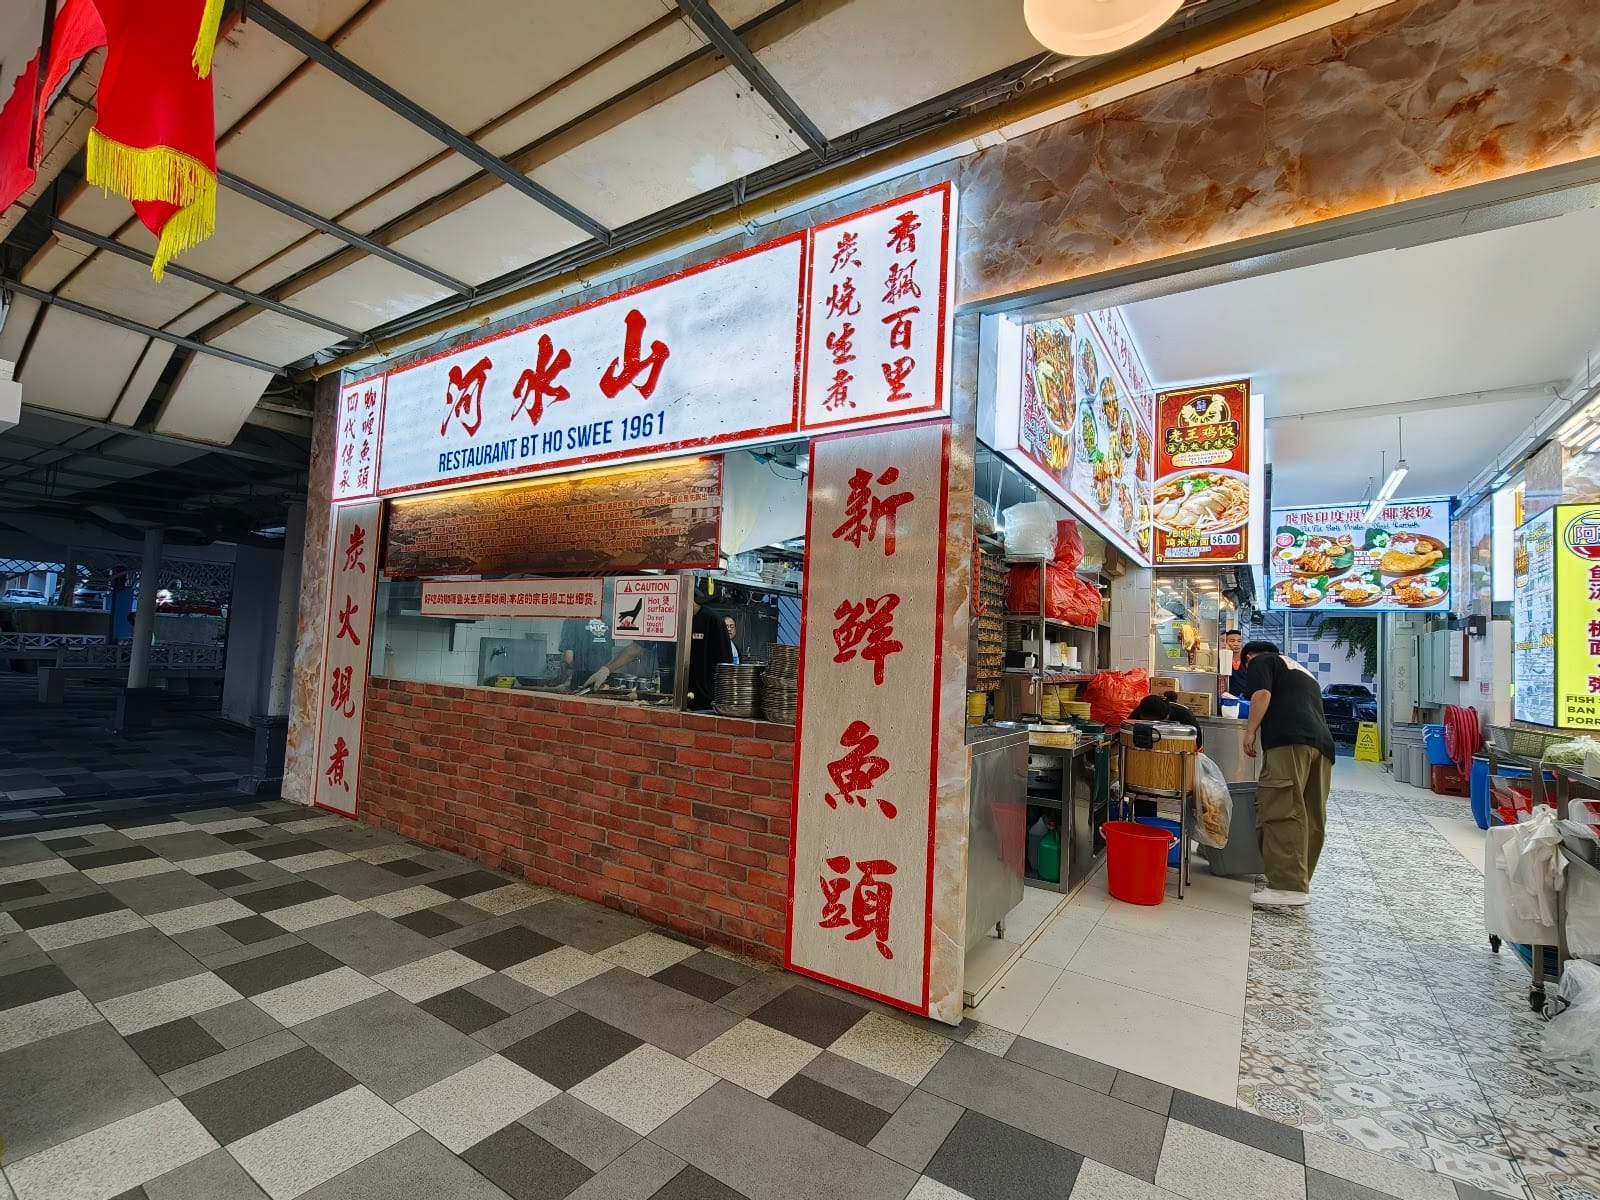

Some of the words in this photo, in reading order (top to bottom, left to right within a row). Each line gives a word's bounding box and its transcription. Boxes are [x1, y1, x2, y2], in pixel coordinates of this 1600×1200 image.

[440, 308, 671, 437] 河水山
[1168, 422, 1236, 442] 老王鸡饭
[438, 438, 518, 472] RESTAURANT
[520, 434, 539, 458] BT
[543, 430, 563, 454] HO
[567, 420, 614, 450] SWEE
[621, 410, 665, 441] 1961
[1212, 534, 1238, 544] $6.00
[634, 582, 670, 592] CAUTION
[647, 596, 660, 605] Hot
[647, 605, 674, 613] surface!
[325, 524, 366, 793] 炭火現煮
[1566, 695, 1595, 704] FISH
[818, 466, 915, 960] 新鮮魚頭
[1567, 706, 1595, 715] BAN
